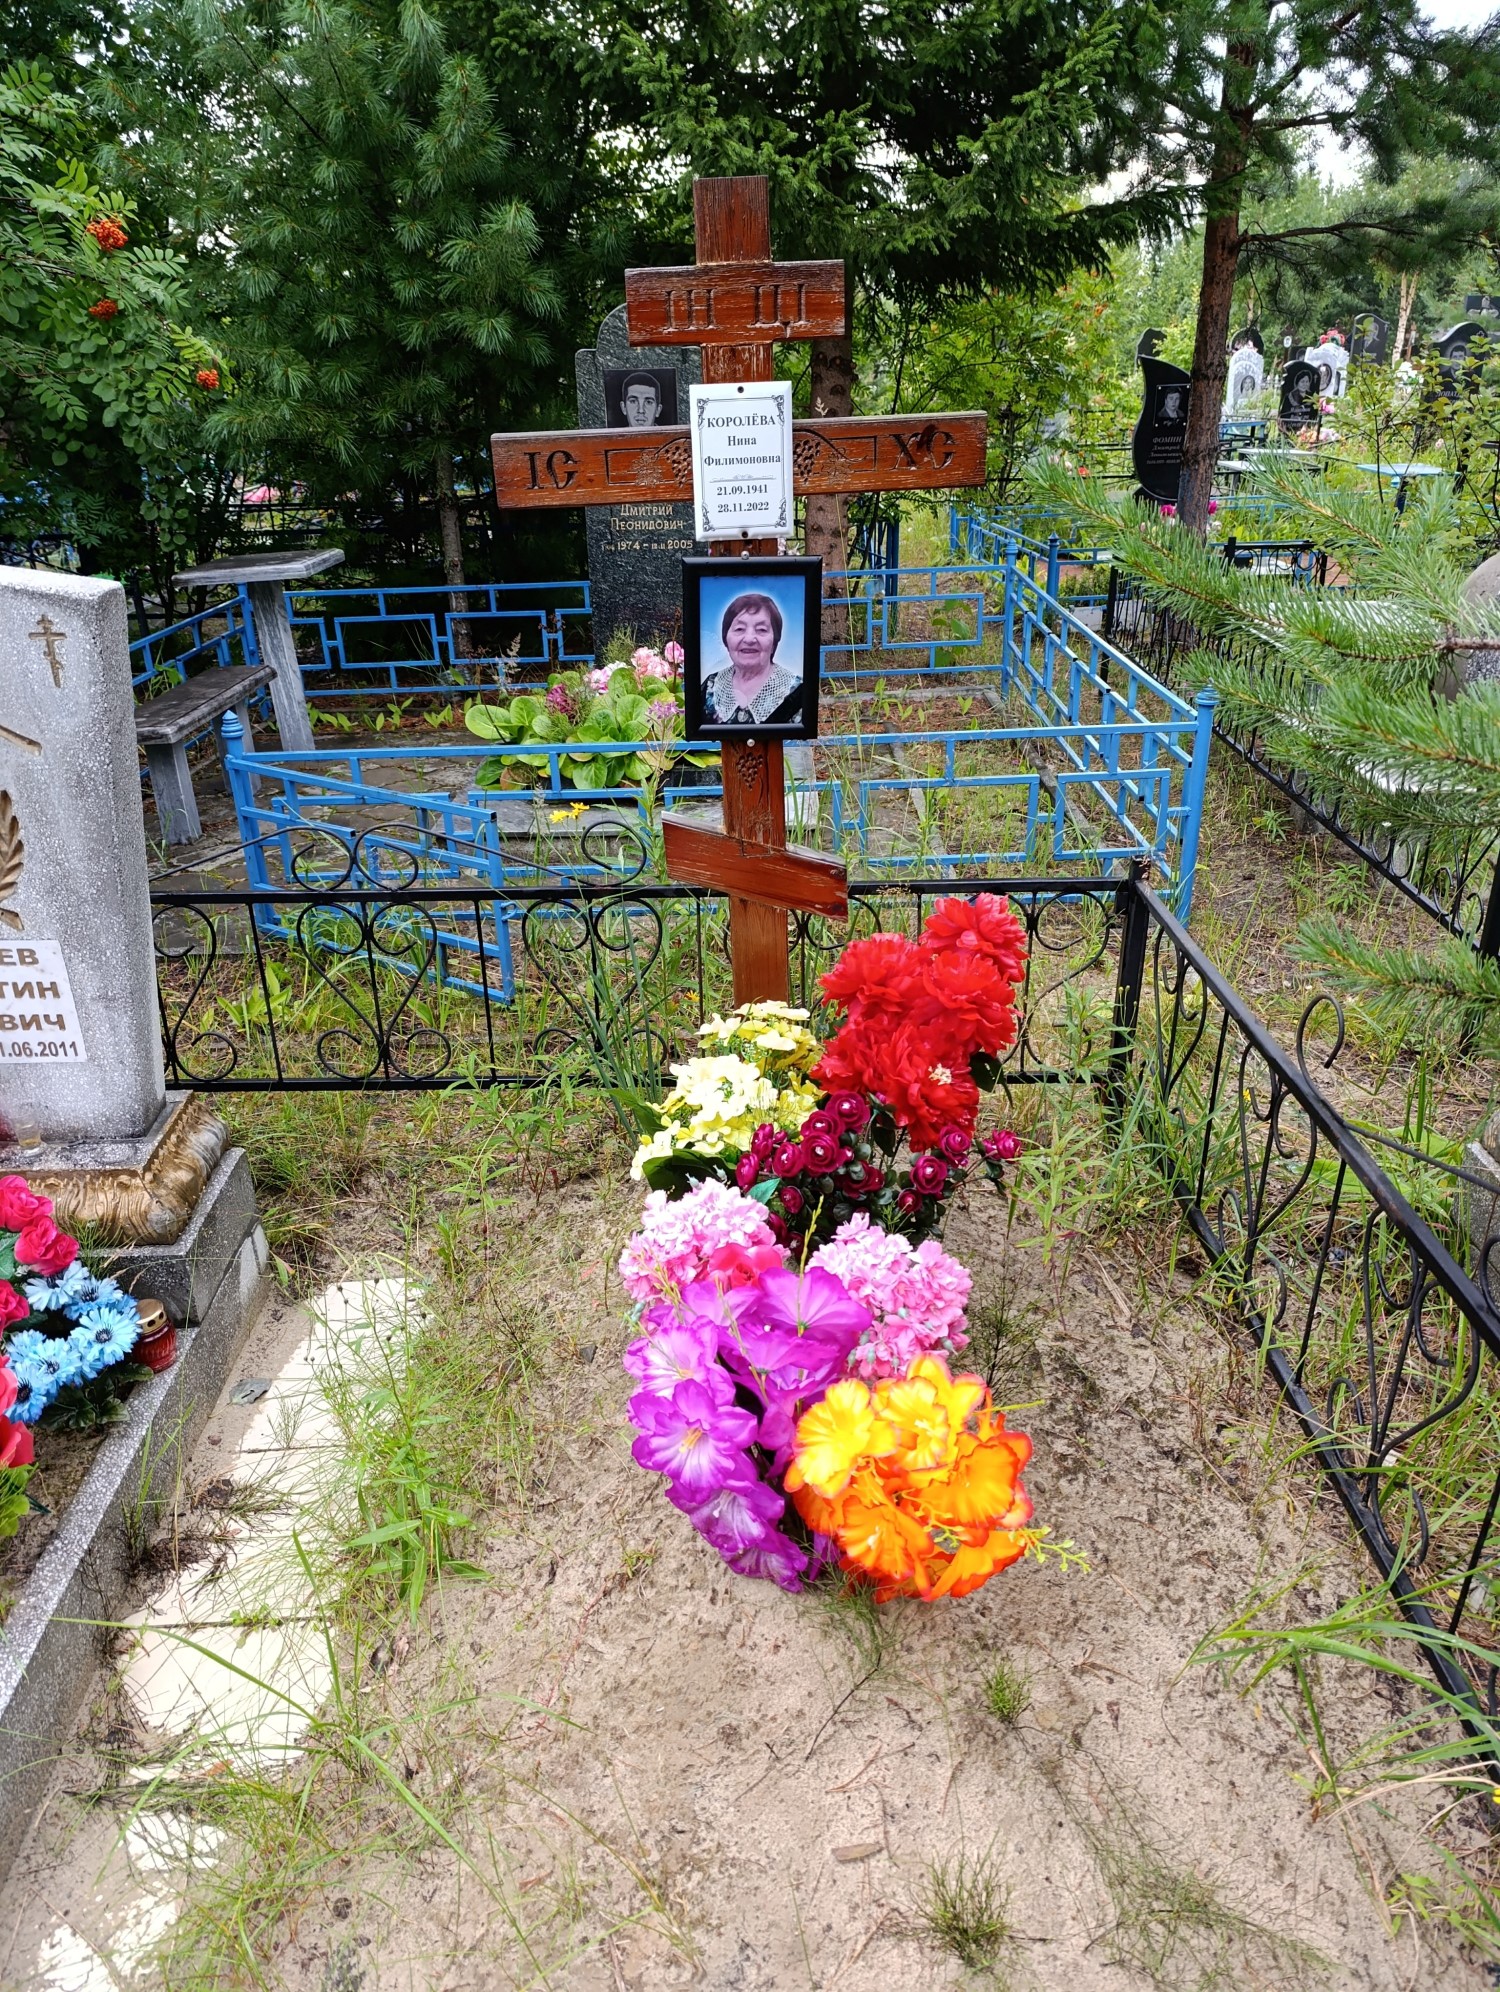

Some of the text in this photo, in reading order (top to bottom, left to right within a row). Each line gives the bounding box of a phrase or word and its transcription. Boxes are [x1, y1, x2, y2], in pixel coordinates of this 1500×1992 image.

[707, 413, 776, 428] КОРОЛЁВА
[727, 435, 757, 447] Нина
[704, 454, 781, 467] Филимоновна
[716, 484, 768, 496] 21.09.1941
[717, 502, 769, 514] 28.11.2022
[617, 541, 640, 551] 1974
[667, 539, 693, 550] 2005
